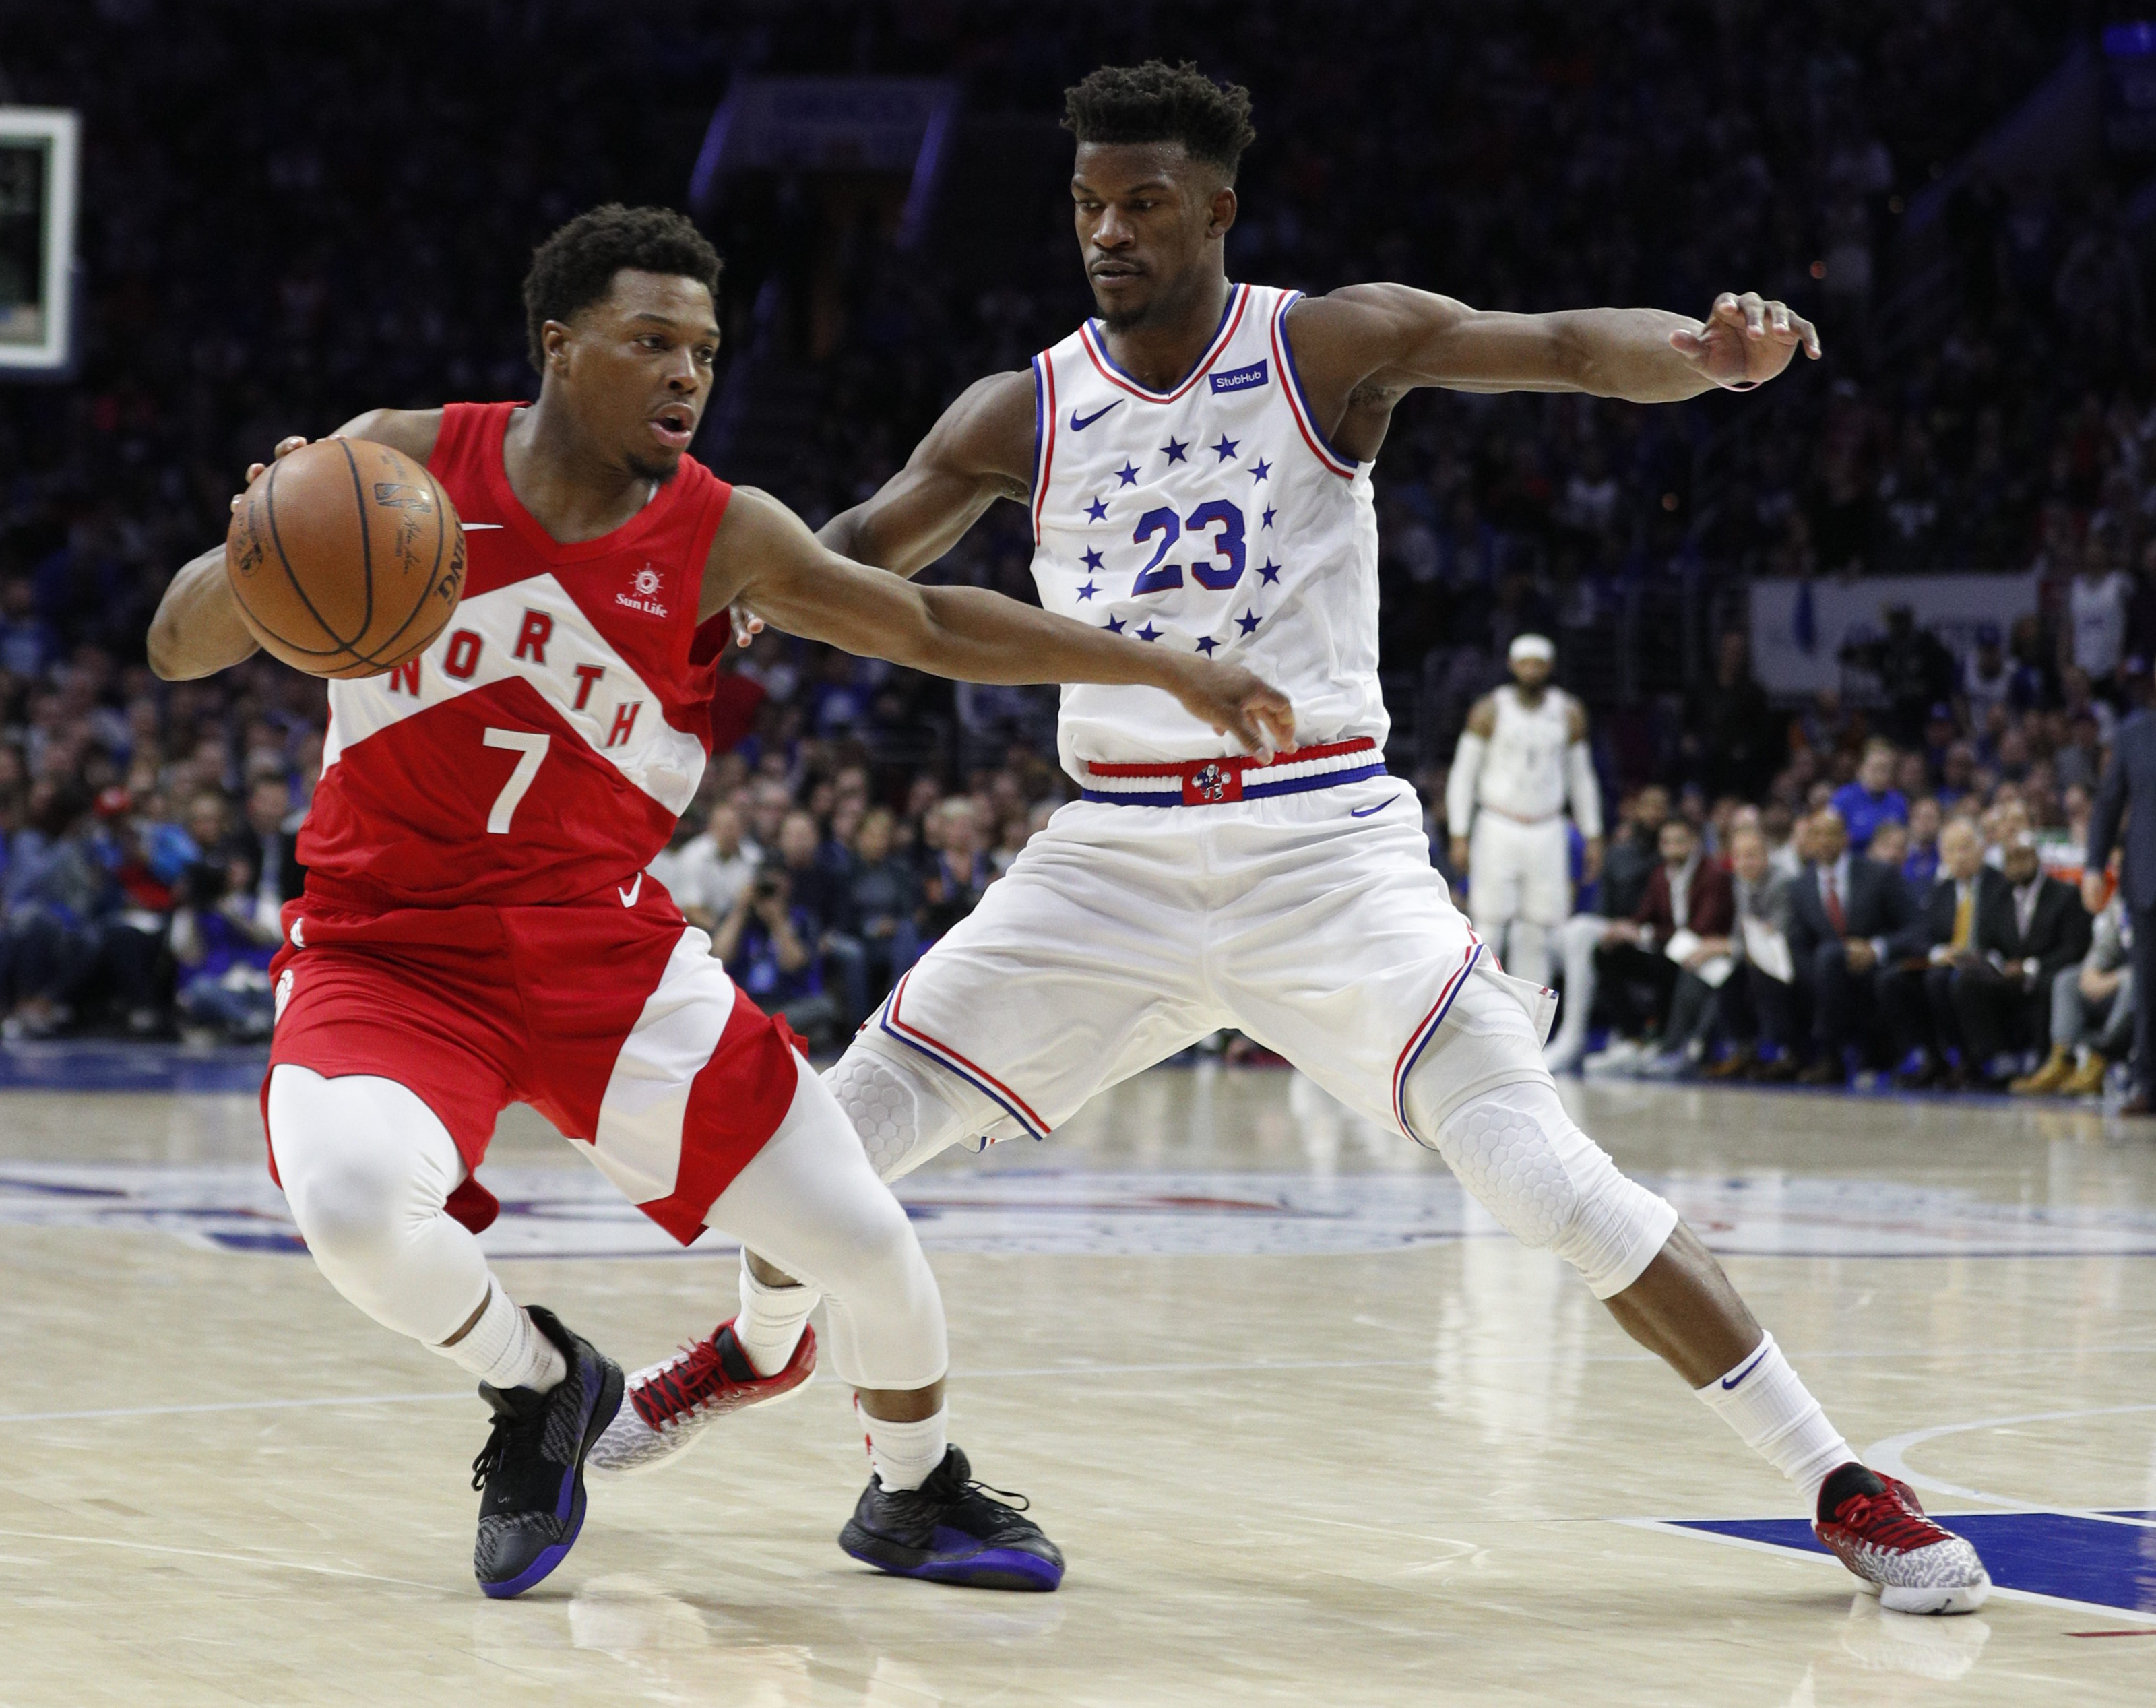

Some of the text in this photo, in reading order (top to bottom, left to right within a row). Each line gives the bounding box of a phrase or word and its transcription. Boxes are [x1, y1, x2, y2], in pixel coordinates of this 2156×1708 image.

[1216, 371, 1261, 387] StubHub
[1132, 499, 1246, 598] 23
[615, 593, 668, 618] Sun Life
[388, 607, 643, 748] NORTH
[483, 727, 550, 834] 7
